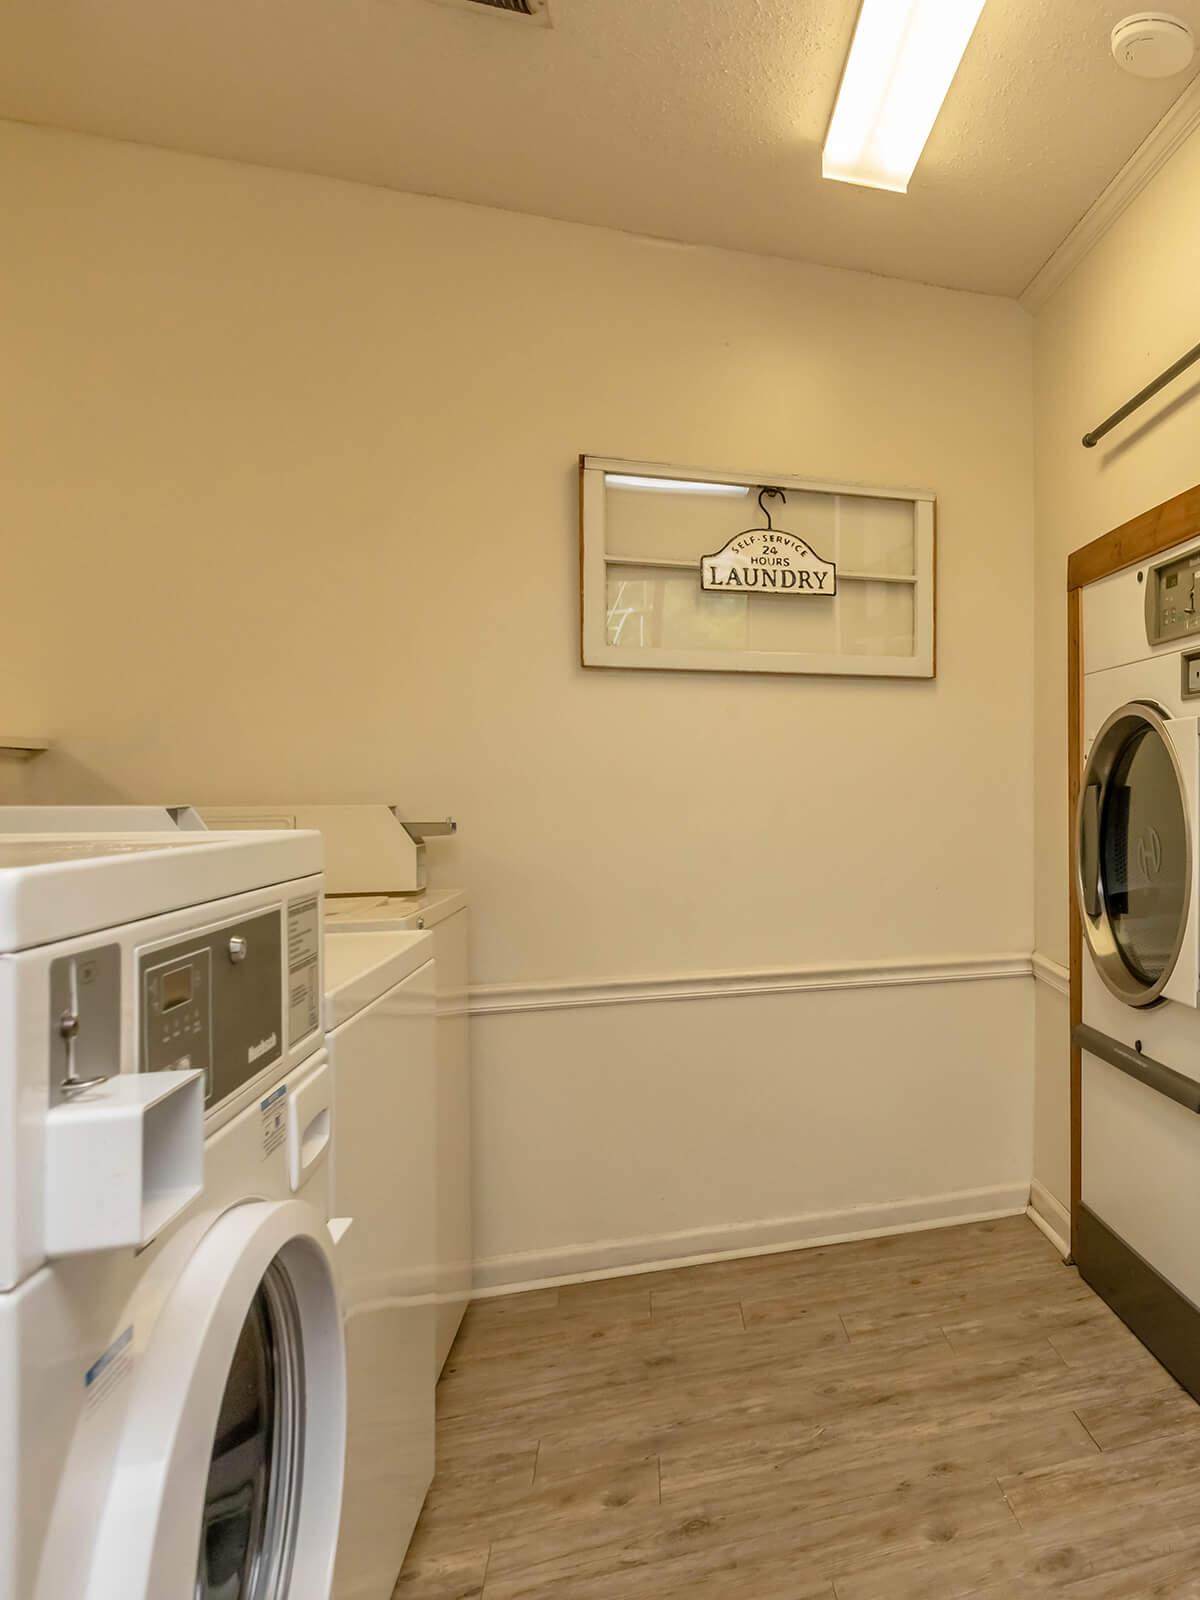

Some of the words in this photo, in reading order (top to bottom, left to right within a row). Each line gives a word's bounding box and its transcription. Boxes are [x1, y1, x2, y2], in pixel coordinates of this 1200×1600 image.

[731, 534, 808, 558] SELF-SERVICE
[762, 545, 778, 556] 24
[750, 556, 790, 567] HOURS
[709, 566, 828, 590] LAUNDRY
